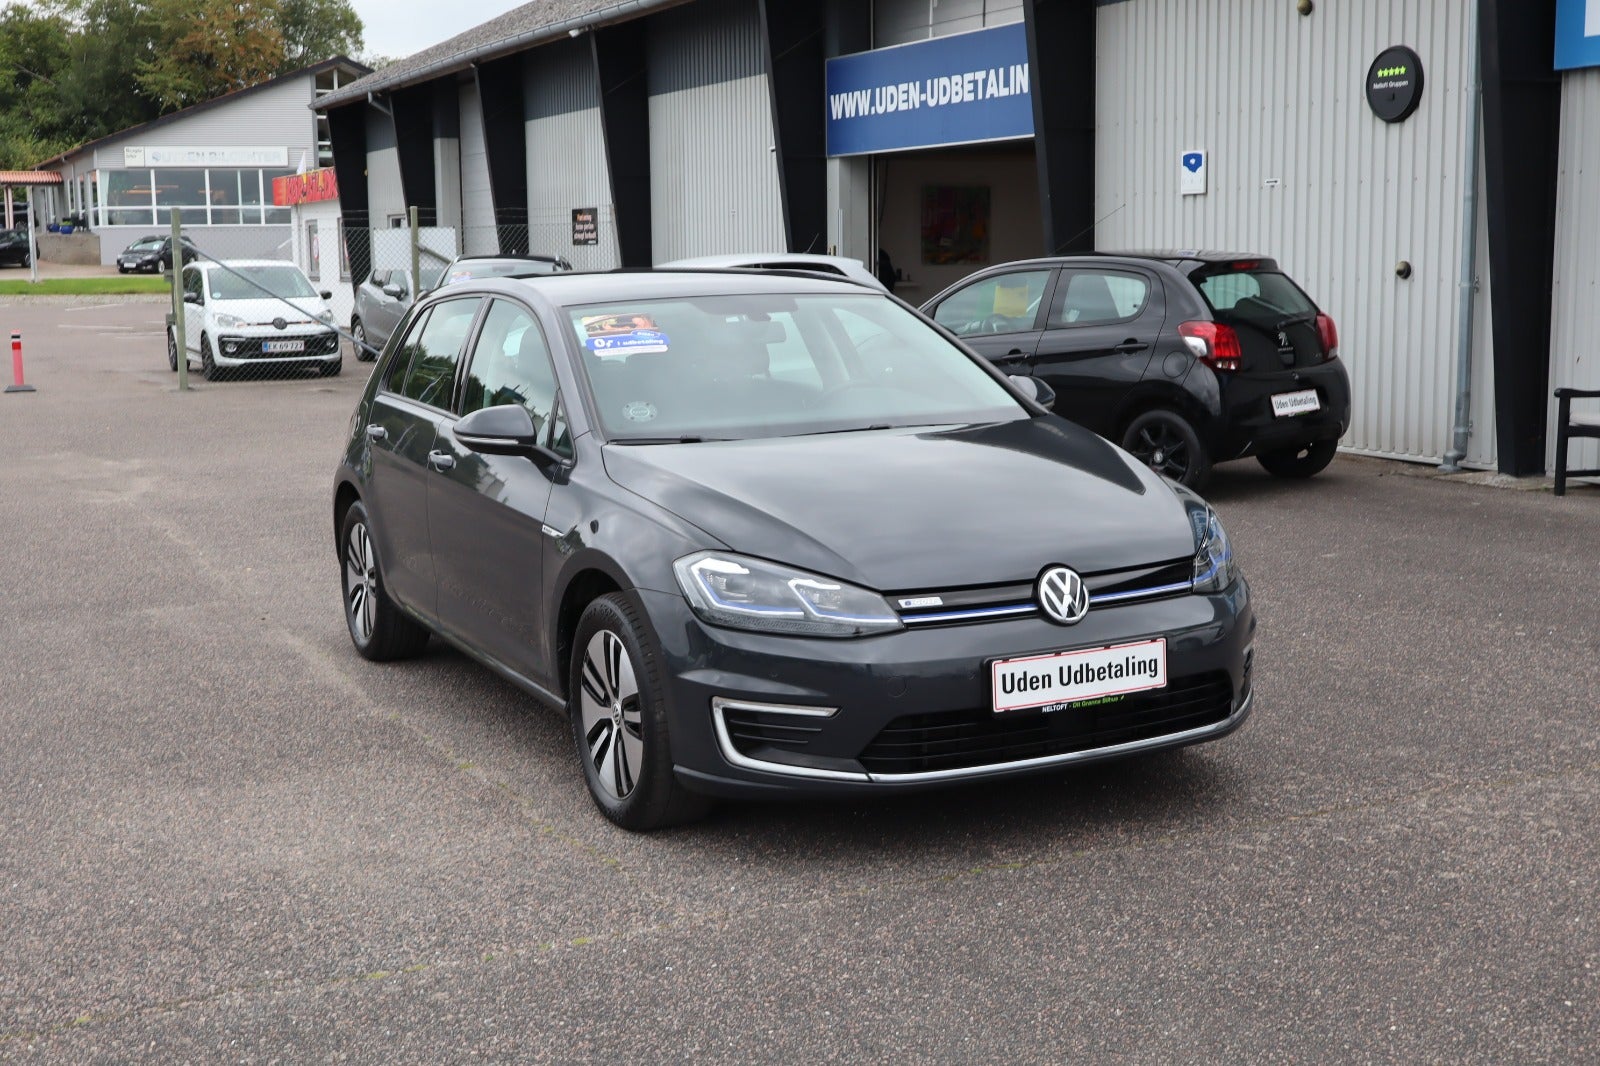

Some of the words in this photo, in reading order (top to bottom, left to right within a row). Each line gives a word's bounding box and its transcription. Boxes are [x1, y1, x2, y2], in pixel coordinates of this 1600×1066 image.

[830, 62, 1029, 120] WWW.UDEN-UDBETALIN
[1002, 671, 1052, 694] Uden
[1059, 655, 1158, 687] Udbetaling
